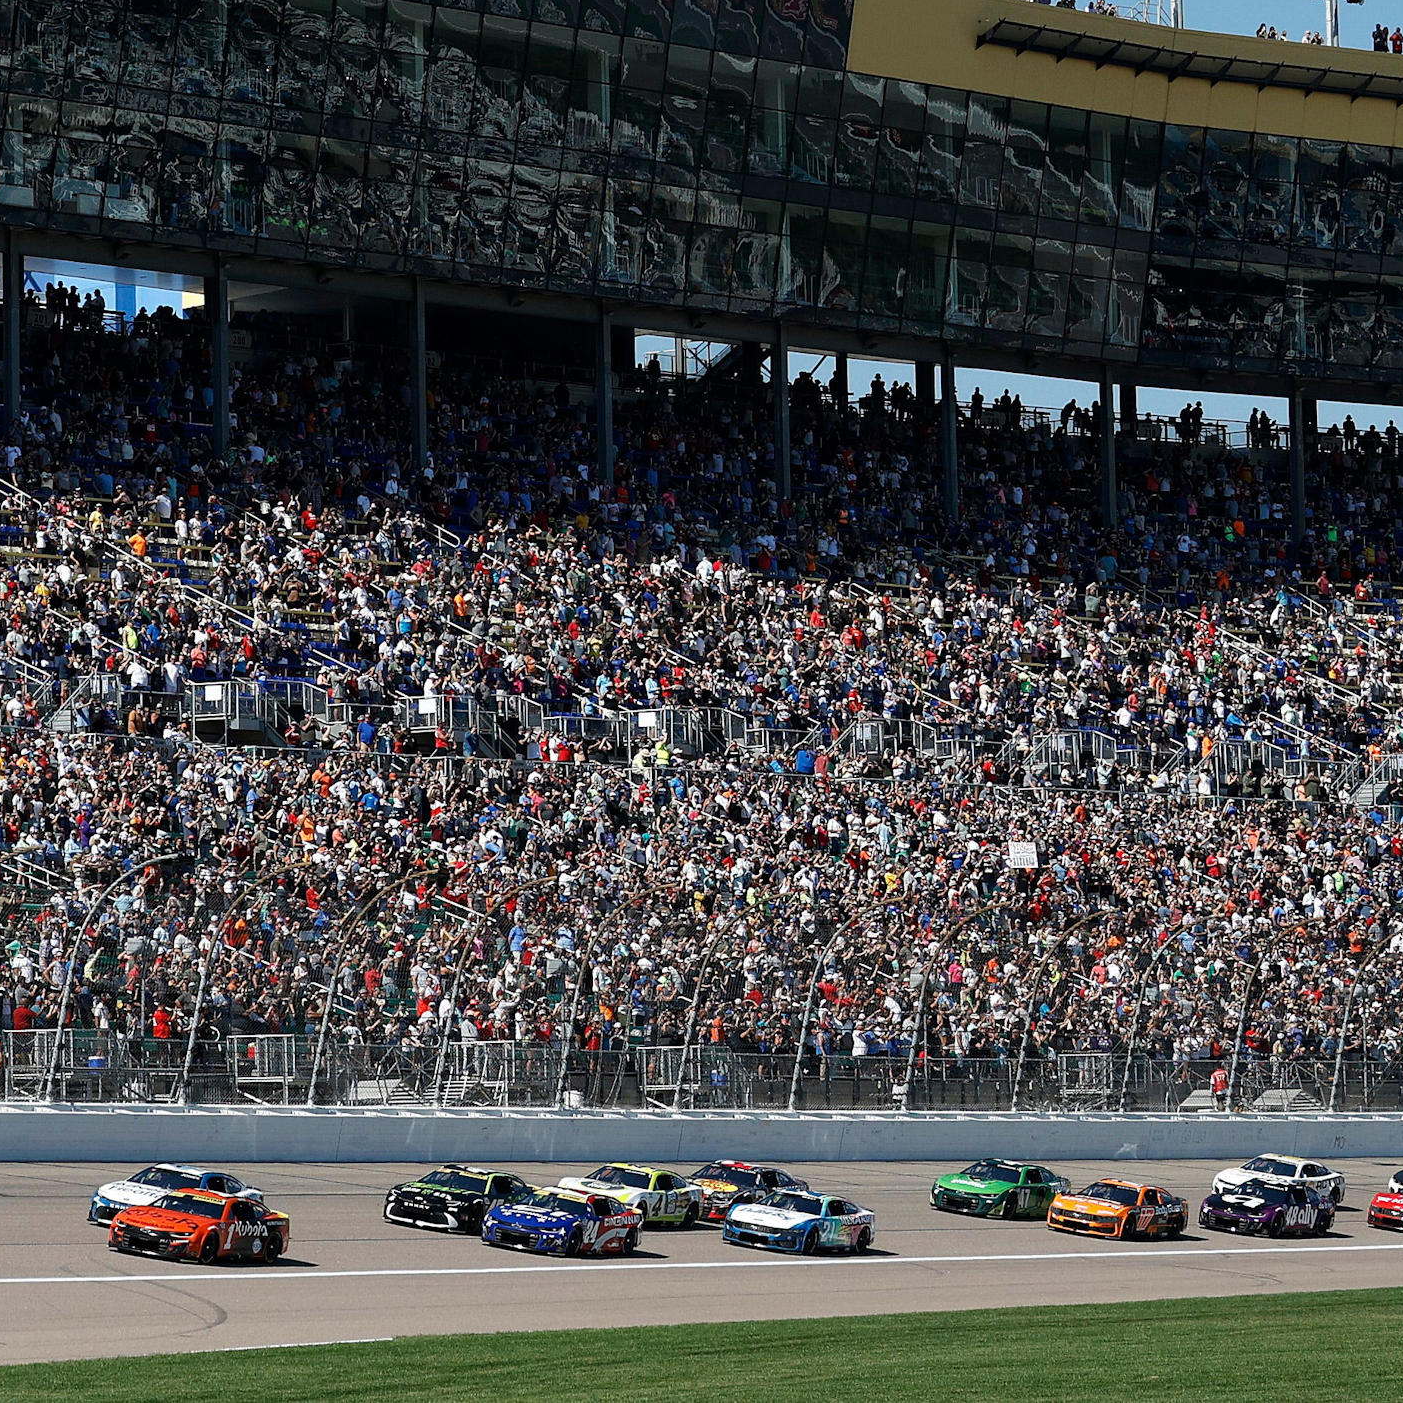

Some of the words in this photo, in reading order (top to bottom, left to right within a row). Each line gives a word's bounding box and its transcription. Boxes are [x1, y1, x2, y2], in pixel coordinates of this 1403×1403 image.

[651, 1194, 665, 1217] 4
[1285, 1205, 1299, 1226] 48
[1299, 1203, 1318, 1229] ally
[235, 1219, 269, 1237] Kubota
[1136, 1208, 1154, 1231] 17
[223, 1223, 235, 1250] 1
[583, 1220, 601, 1244] 24
[822, 1221, 835, 1242] 21
